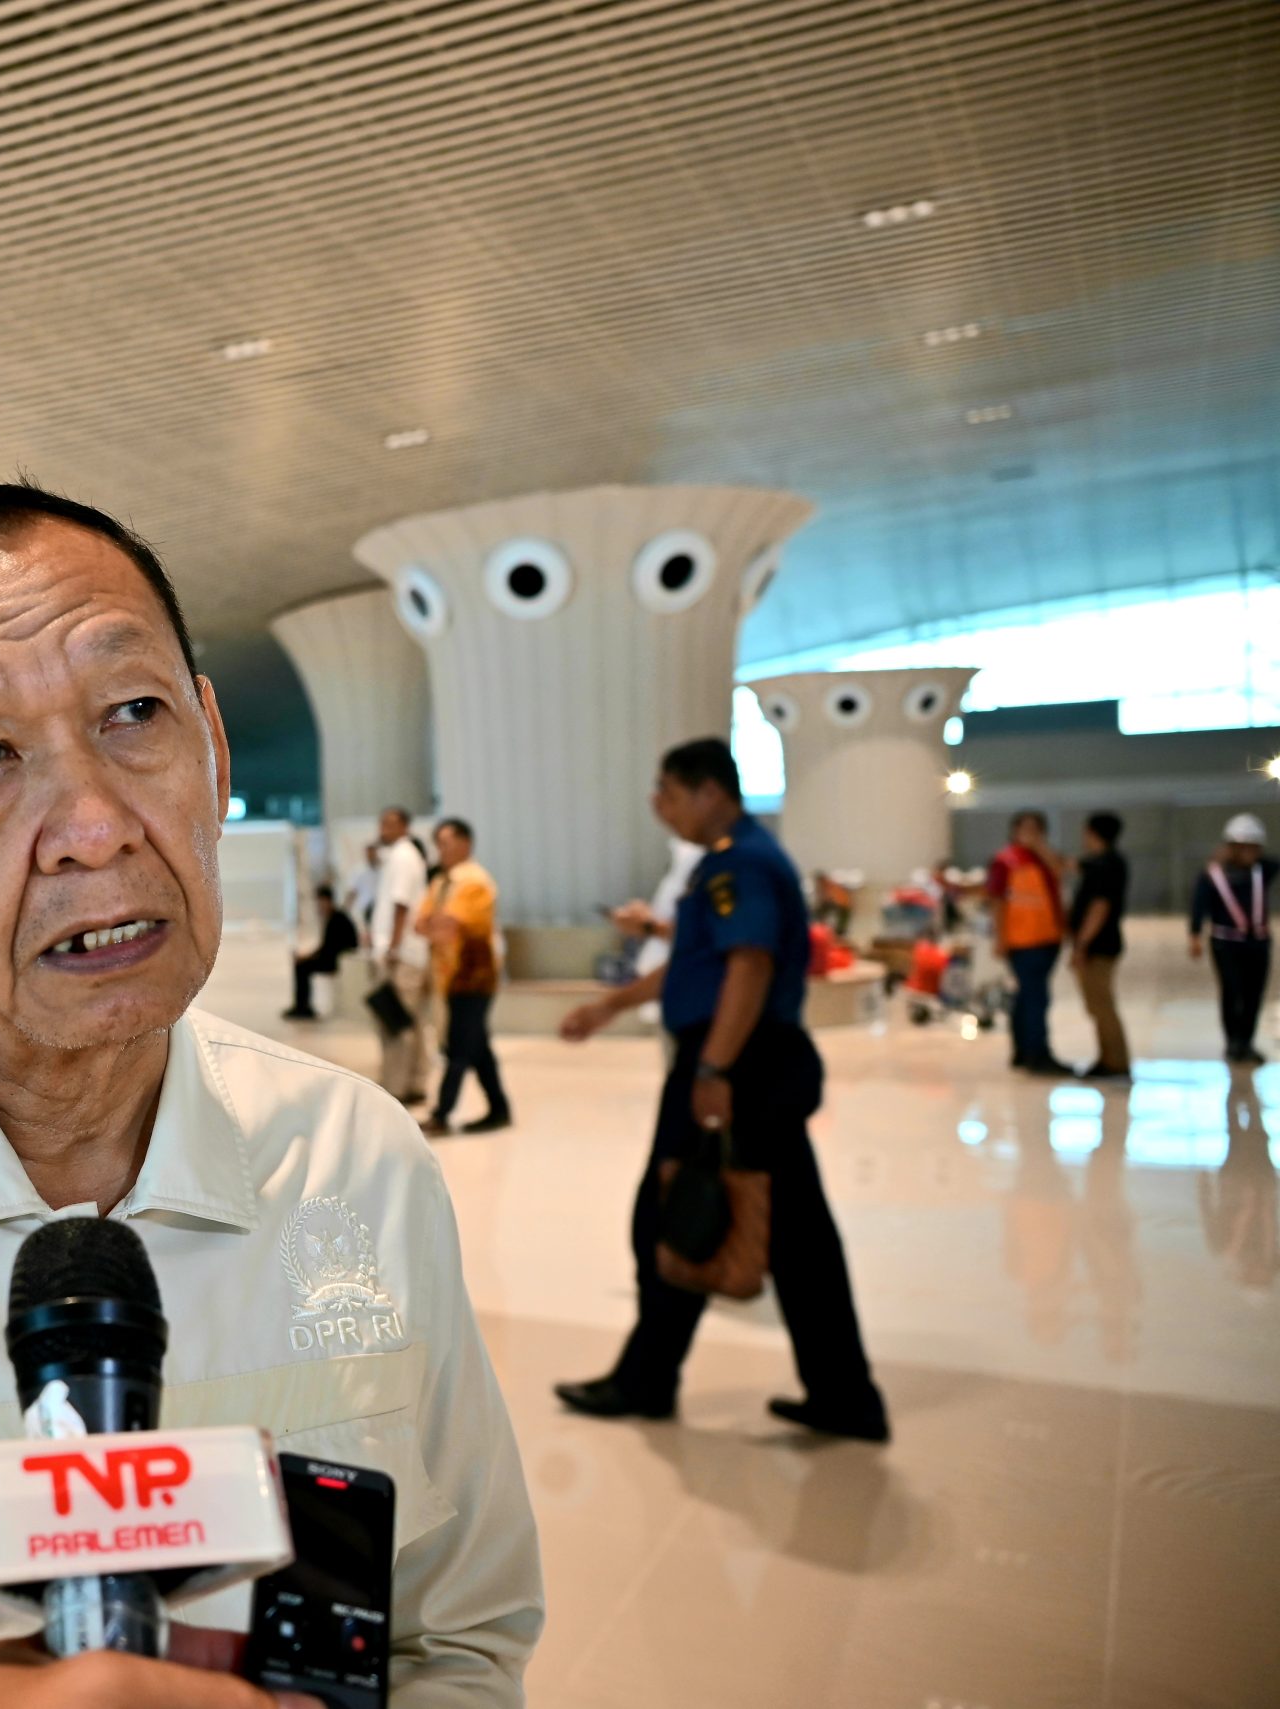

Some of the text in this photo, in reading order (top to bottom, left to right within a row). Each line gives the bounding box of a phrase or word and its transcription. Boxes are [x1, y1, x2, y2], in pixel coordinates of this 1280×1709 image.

[289, 1311, 404, 1350] DPR RI
[29, 1520, 206, 1559] PARLEMEN
